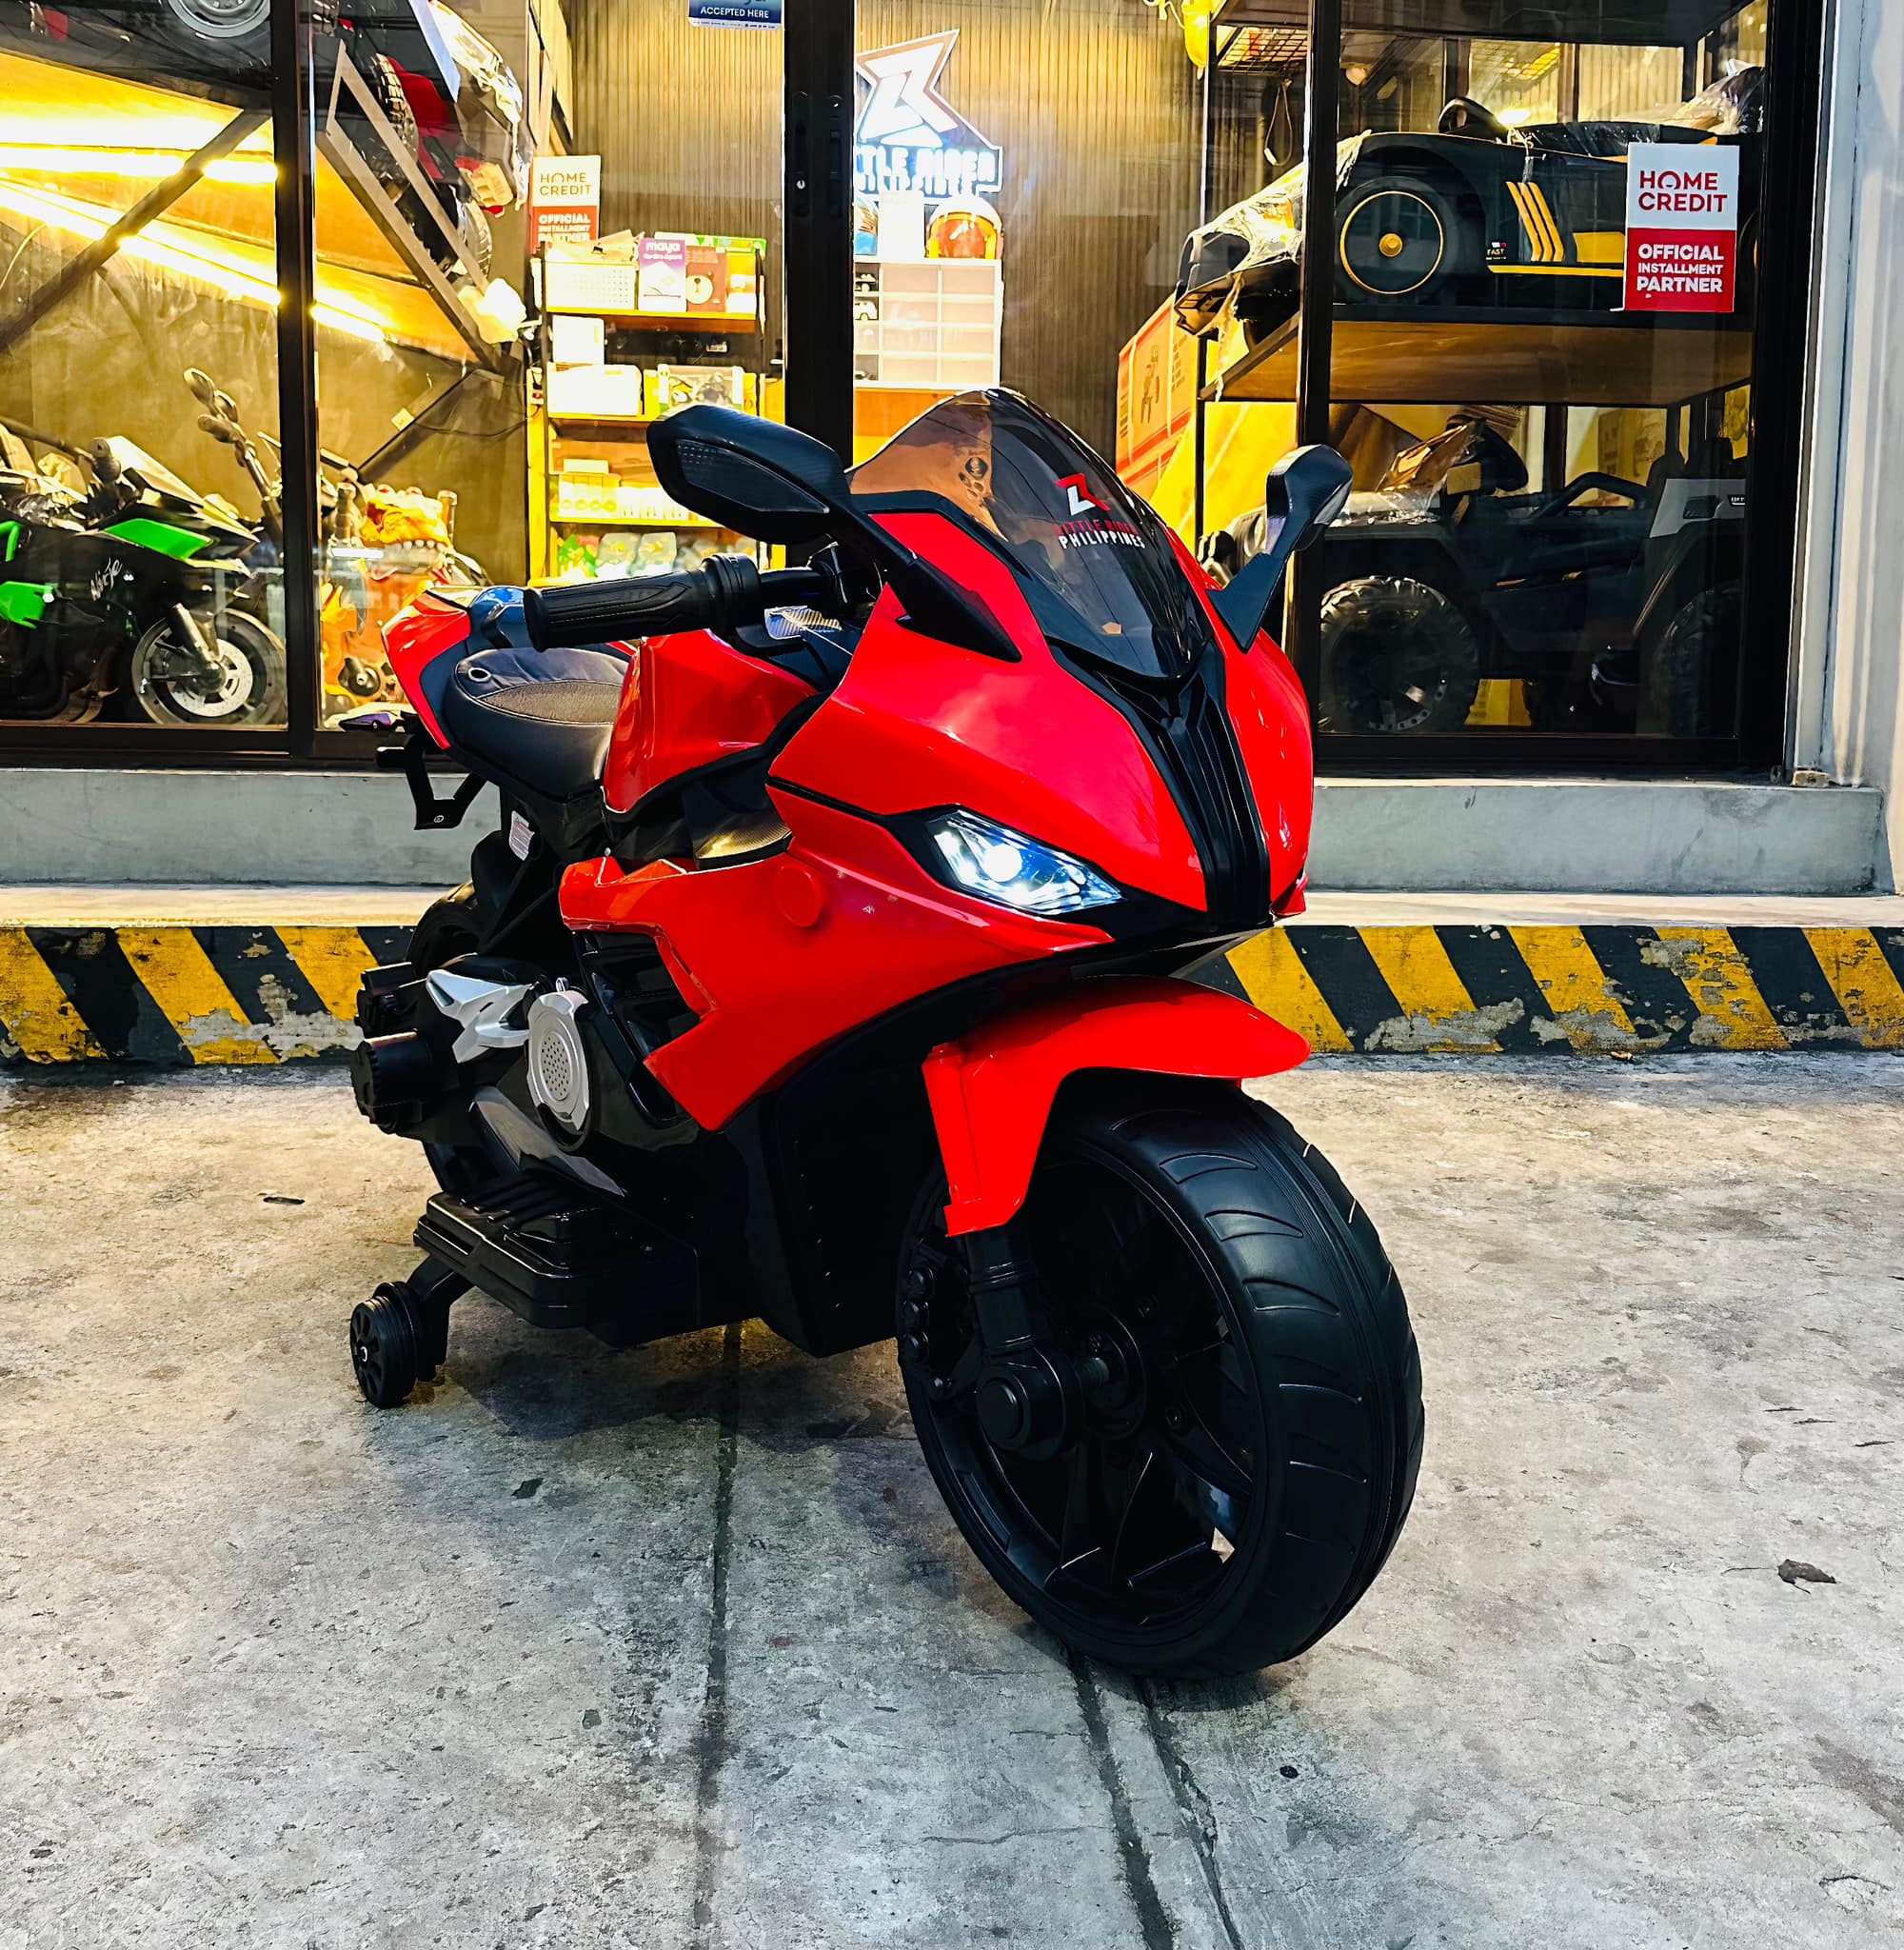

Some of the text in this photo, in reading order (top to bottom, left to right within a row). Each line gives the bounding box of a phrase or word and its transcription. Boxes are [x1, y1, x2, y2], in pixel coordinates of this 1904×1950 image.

[700, 7, 770, 18] ACCEPTED HERE
[540, 172, 587, 184] HOME
[1639, 169, 1718, 190] HOME
[539, 184, 593, 196] CREDIT
[1637, 191, 1728, 212] CREDIT
[538, 213, 591, 225] OFFICIAL
[645, 241, 681, 254] maya
[1637, 243, 1725, 261] OFFICIAL
[1637, 262, 1724, 275] INSTALLMENT
[1636, 276, 1723, 293] PARTNER
[1058, 529, 1146, 549] PHILIPPINES
